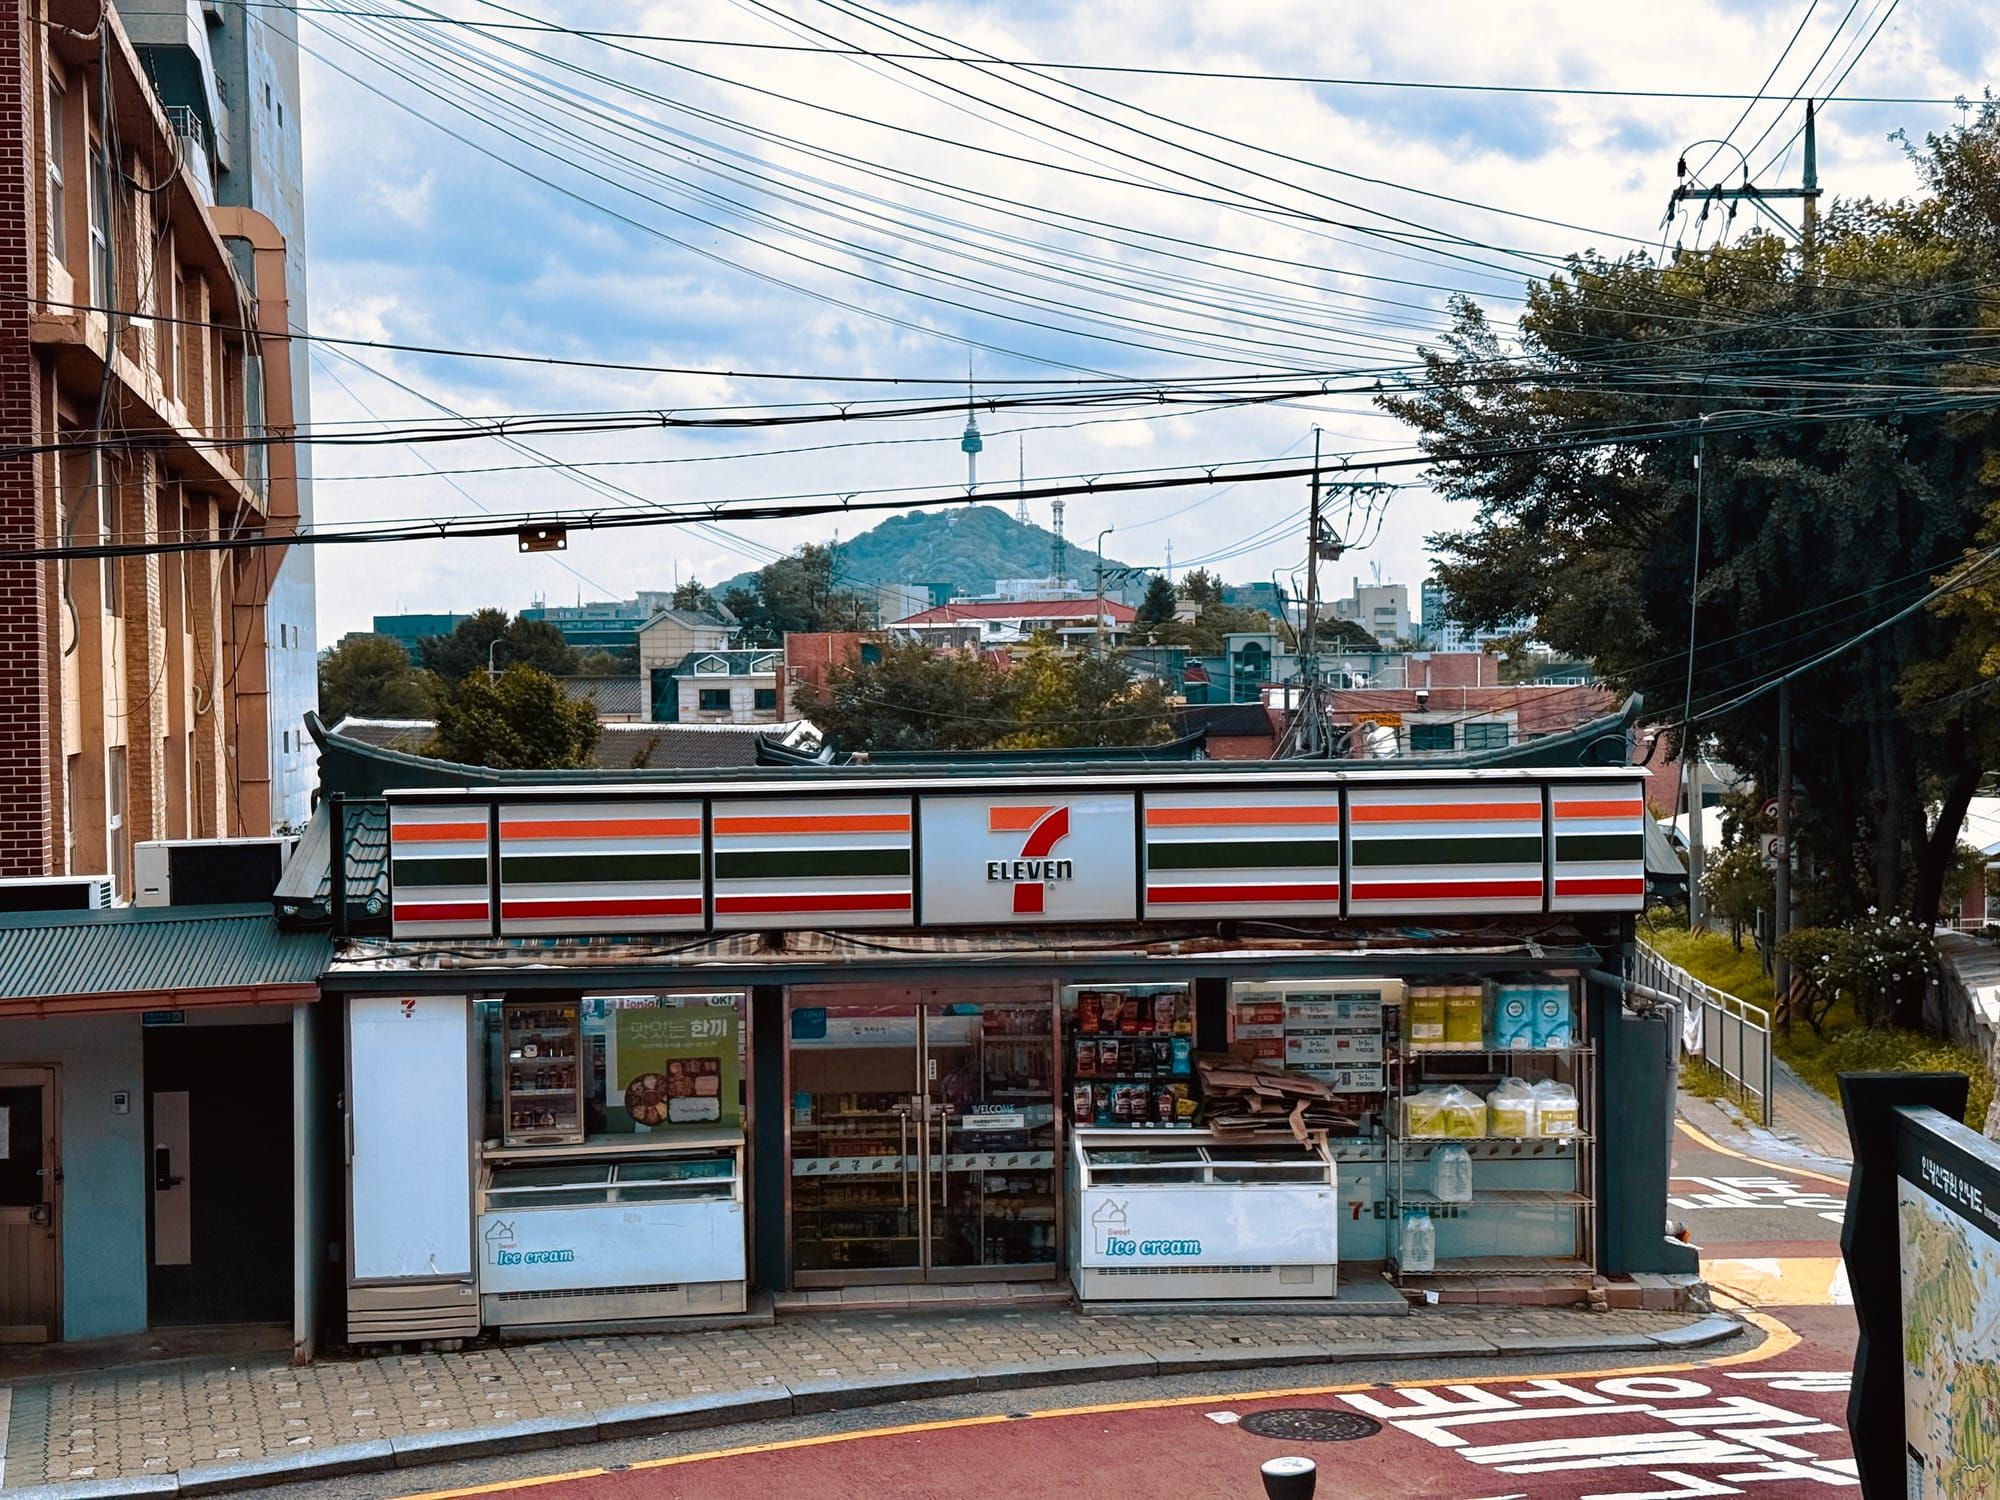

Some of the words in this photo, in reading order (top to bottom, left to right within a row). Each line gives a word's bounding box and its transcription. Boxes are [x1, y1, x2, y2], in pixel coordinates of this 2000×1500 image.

[988, 805, 1071, 914] 7
[631, 1020, 686, 1040] 맛있는
[690, 1018, 728, 1039] 한끼
[971, 1103, 1016, 1115] WELCOME
[1921, 1155, 1958, 1199] 인왕산공원
[1958, 1178, 1984, 1214] 안내도
[1107, 1228, 1131, 1236] Sweet
[1106, 1237, 1136, 1256] Ice
[1139, 1239, 1202, 1256] cream
[497, 1250, 522, 1266] Ice
[524, 1249, 575, 1264] cream
